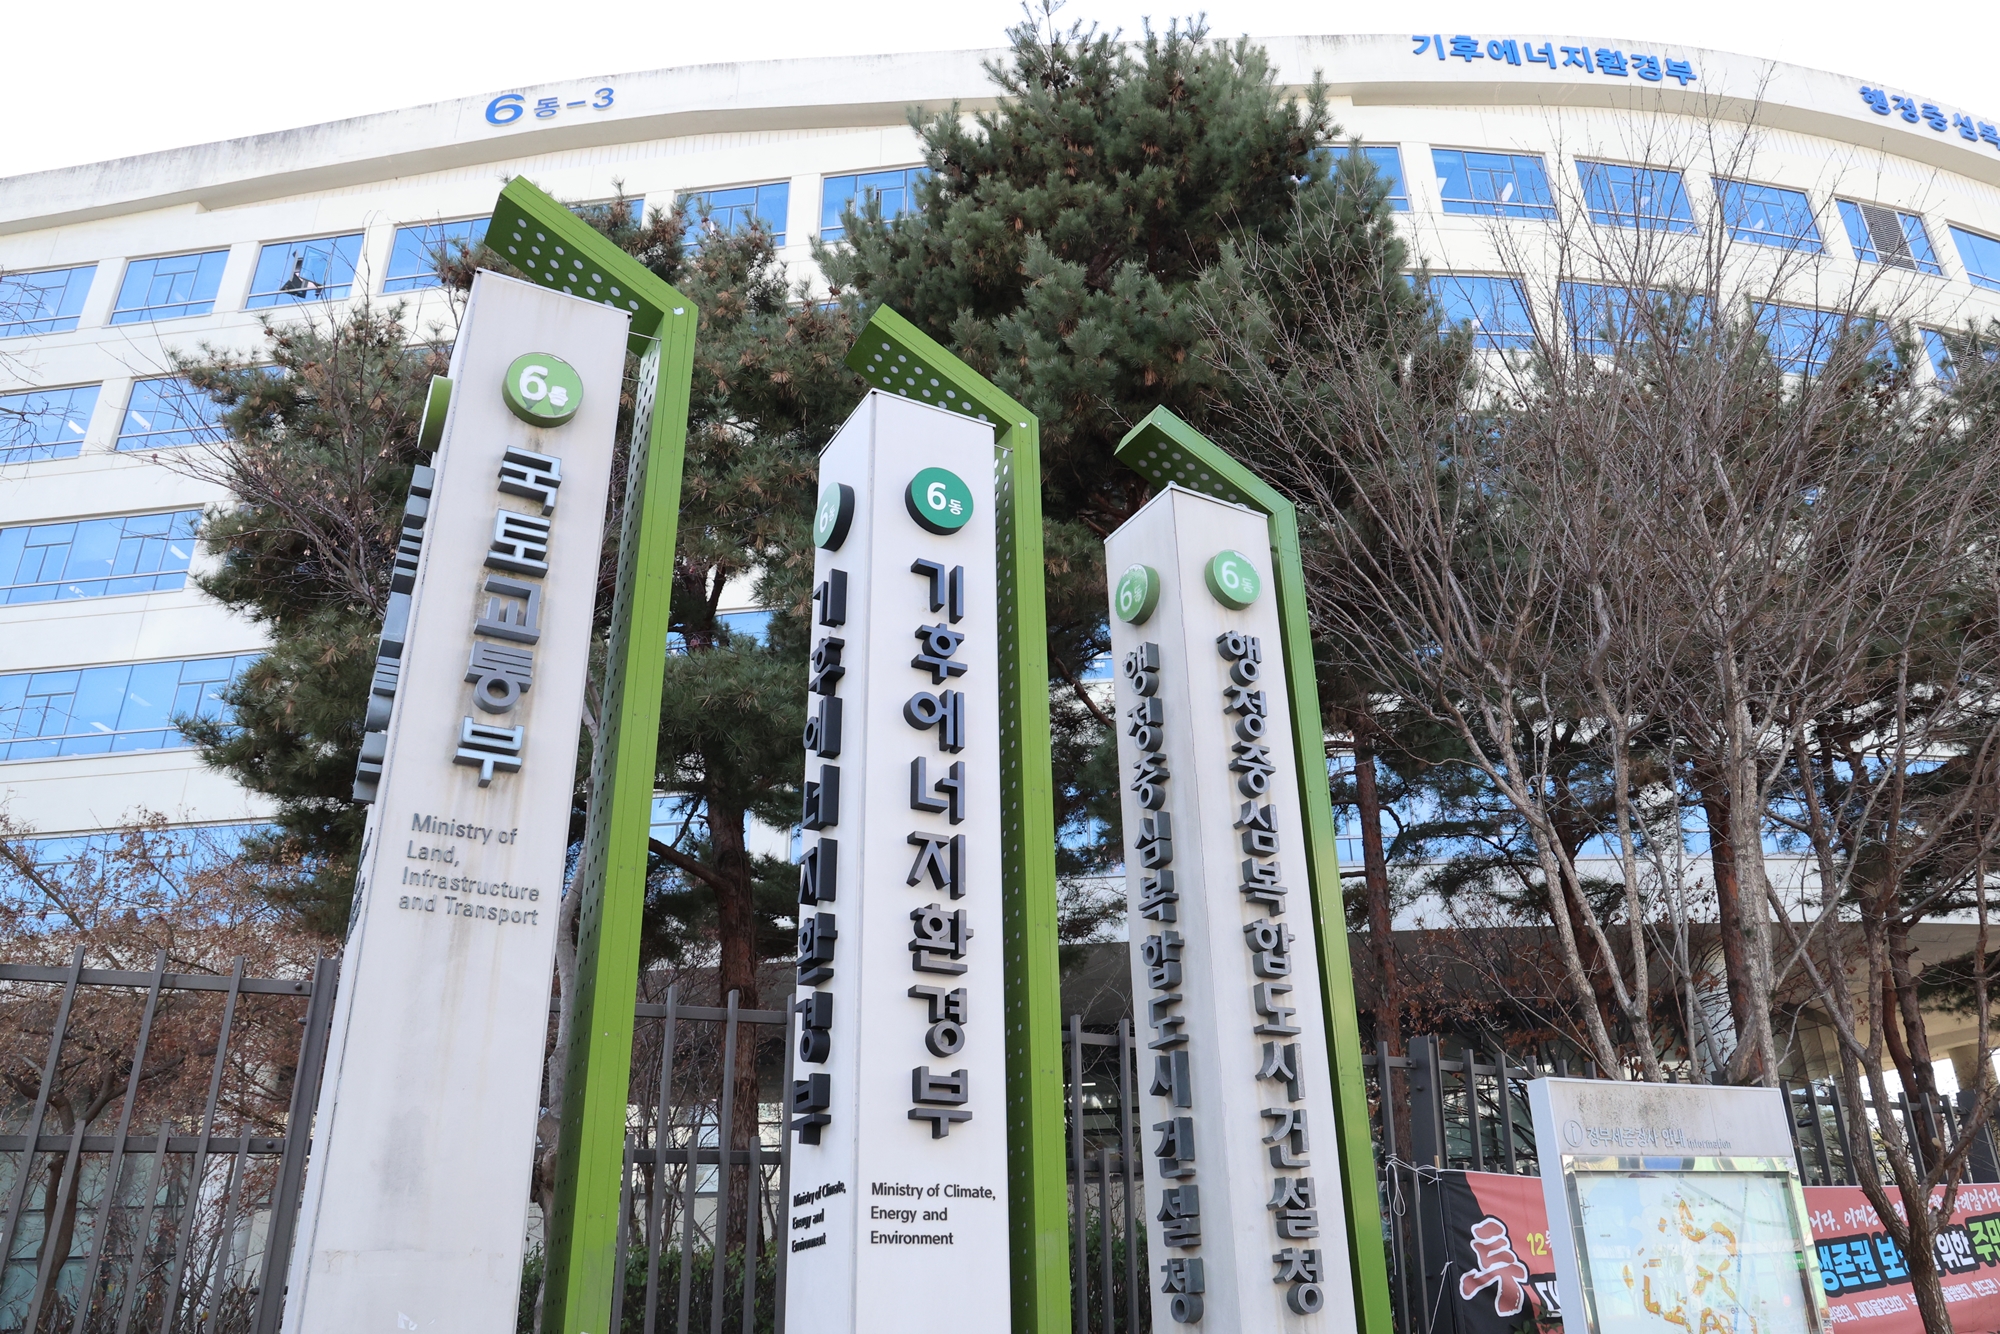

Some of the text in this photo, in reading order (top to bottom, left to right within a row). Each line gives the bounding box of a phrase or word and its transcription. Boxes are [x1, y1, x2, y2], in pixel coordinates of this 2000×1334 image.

[1411, 33, 1697, 86] 기후에너지환경부
[926, 482, 963, 516] 6동
[819, 500, 836, 534] 6동
[1221, 560, 1255, 594] 6동
[1120, 579, 1143, 613] 6동
[452, 445, 562, 788] 국토교통부
[411, 812, 518, 846] Ministry of
[406, 839, 460, 868] Land,
[790, 568, 848, 1146] 기후에너지환경부
[902, 557, 974, 1140] 기후에너지환경부
[402, 866, 540, 902] Infrastructure
[399, 894, 539, 926] and Transport
[1122, 641, 1206, 1325] 행정중심복합도시건설청
[1216, 629, 1325, 1316] 행정중심복합도시건설청
[1586, 1126, 1685, 1148] 정부세종청사 안내
[871, 1182, 996, 1201] Ministry of Climate,
[1953, 1187, 2000, 1214] 례입니다
[870, 1206, 948, 1223] Energy and
[870, 1230, 954, 1245] Environment
[1935, 1230, 1976, 1269] 위한
